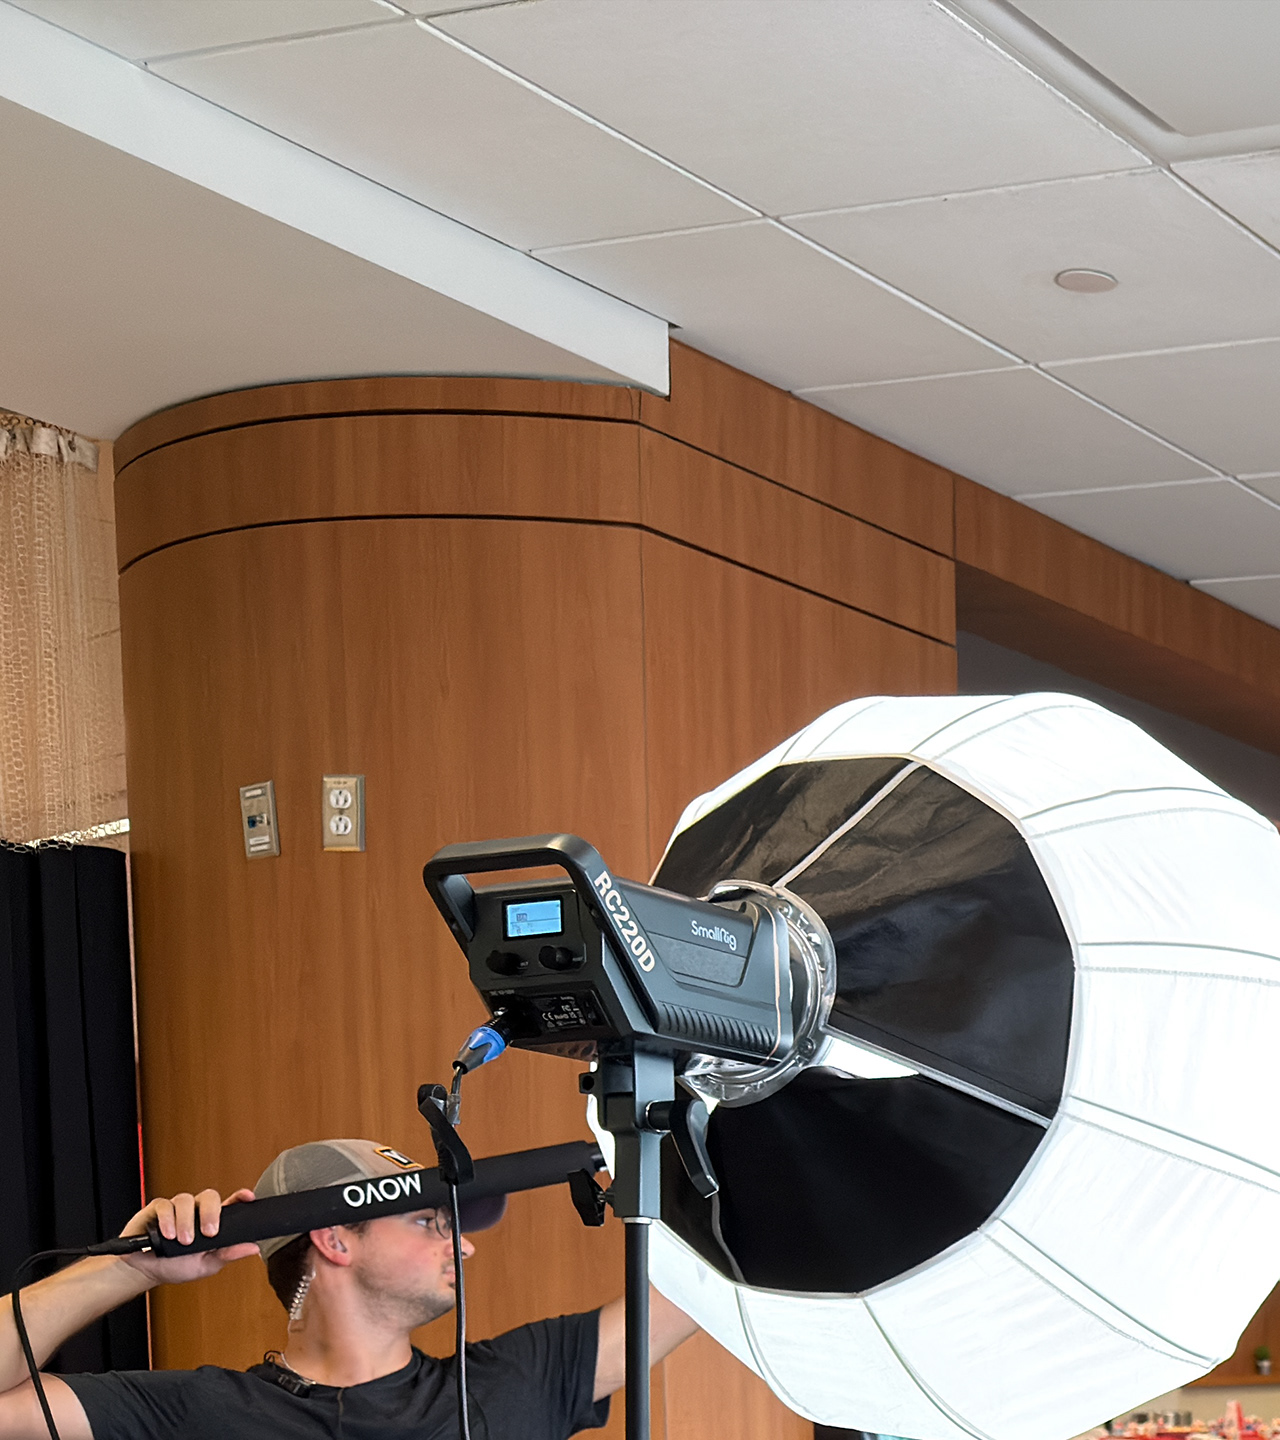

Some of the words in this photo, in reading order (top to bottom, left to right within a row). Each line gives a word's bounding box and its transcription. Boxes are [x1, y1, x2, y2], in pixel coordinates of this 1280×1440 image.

[594, 870, 656, 973] RC220D
[691, 919, 737, 951] SmallRig
[343, 1173, 421, 1208] MOVO
